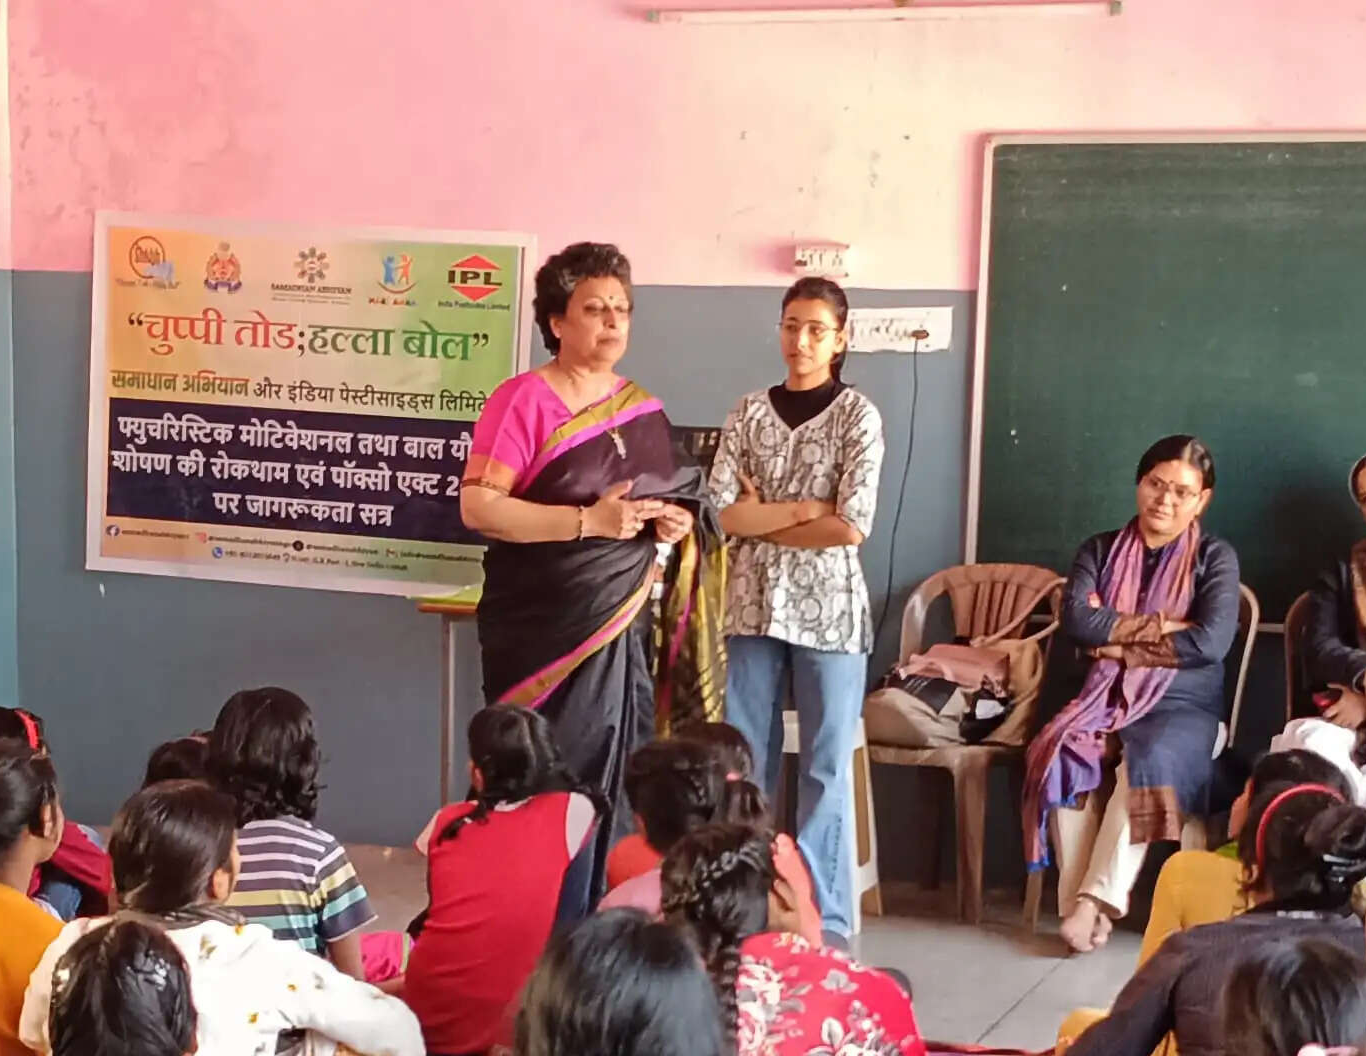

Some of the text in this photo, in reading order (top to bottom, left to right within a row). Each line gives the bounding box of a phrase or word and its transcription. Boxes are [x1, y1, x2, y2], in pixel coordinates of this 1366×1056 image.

[447, 270, 503, 287] IPL
[110, 370, 178, 392] समाधान
[182, 370, 250, 397] अभियान
[287, 379, 335, 404] इंडिया
[238, 417, 354, 454] मोटिवेशनल
[357, 432, 399, 457] तथा
[403, 435, 446, 461] बाल
[111, 444, 173, 475] शोषण
[176, 448, 206, 478] की
[209, 450, 291, 484] रोकथाम
[294, 460, 326, 489] एवं
[330, 459, 392, 492] पॉक्सो
[396, 470, 442, 497] एक्ट
[212, 492, 395, 527] पर जागरूकता सत्र
